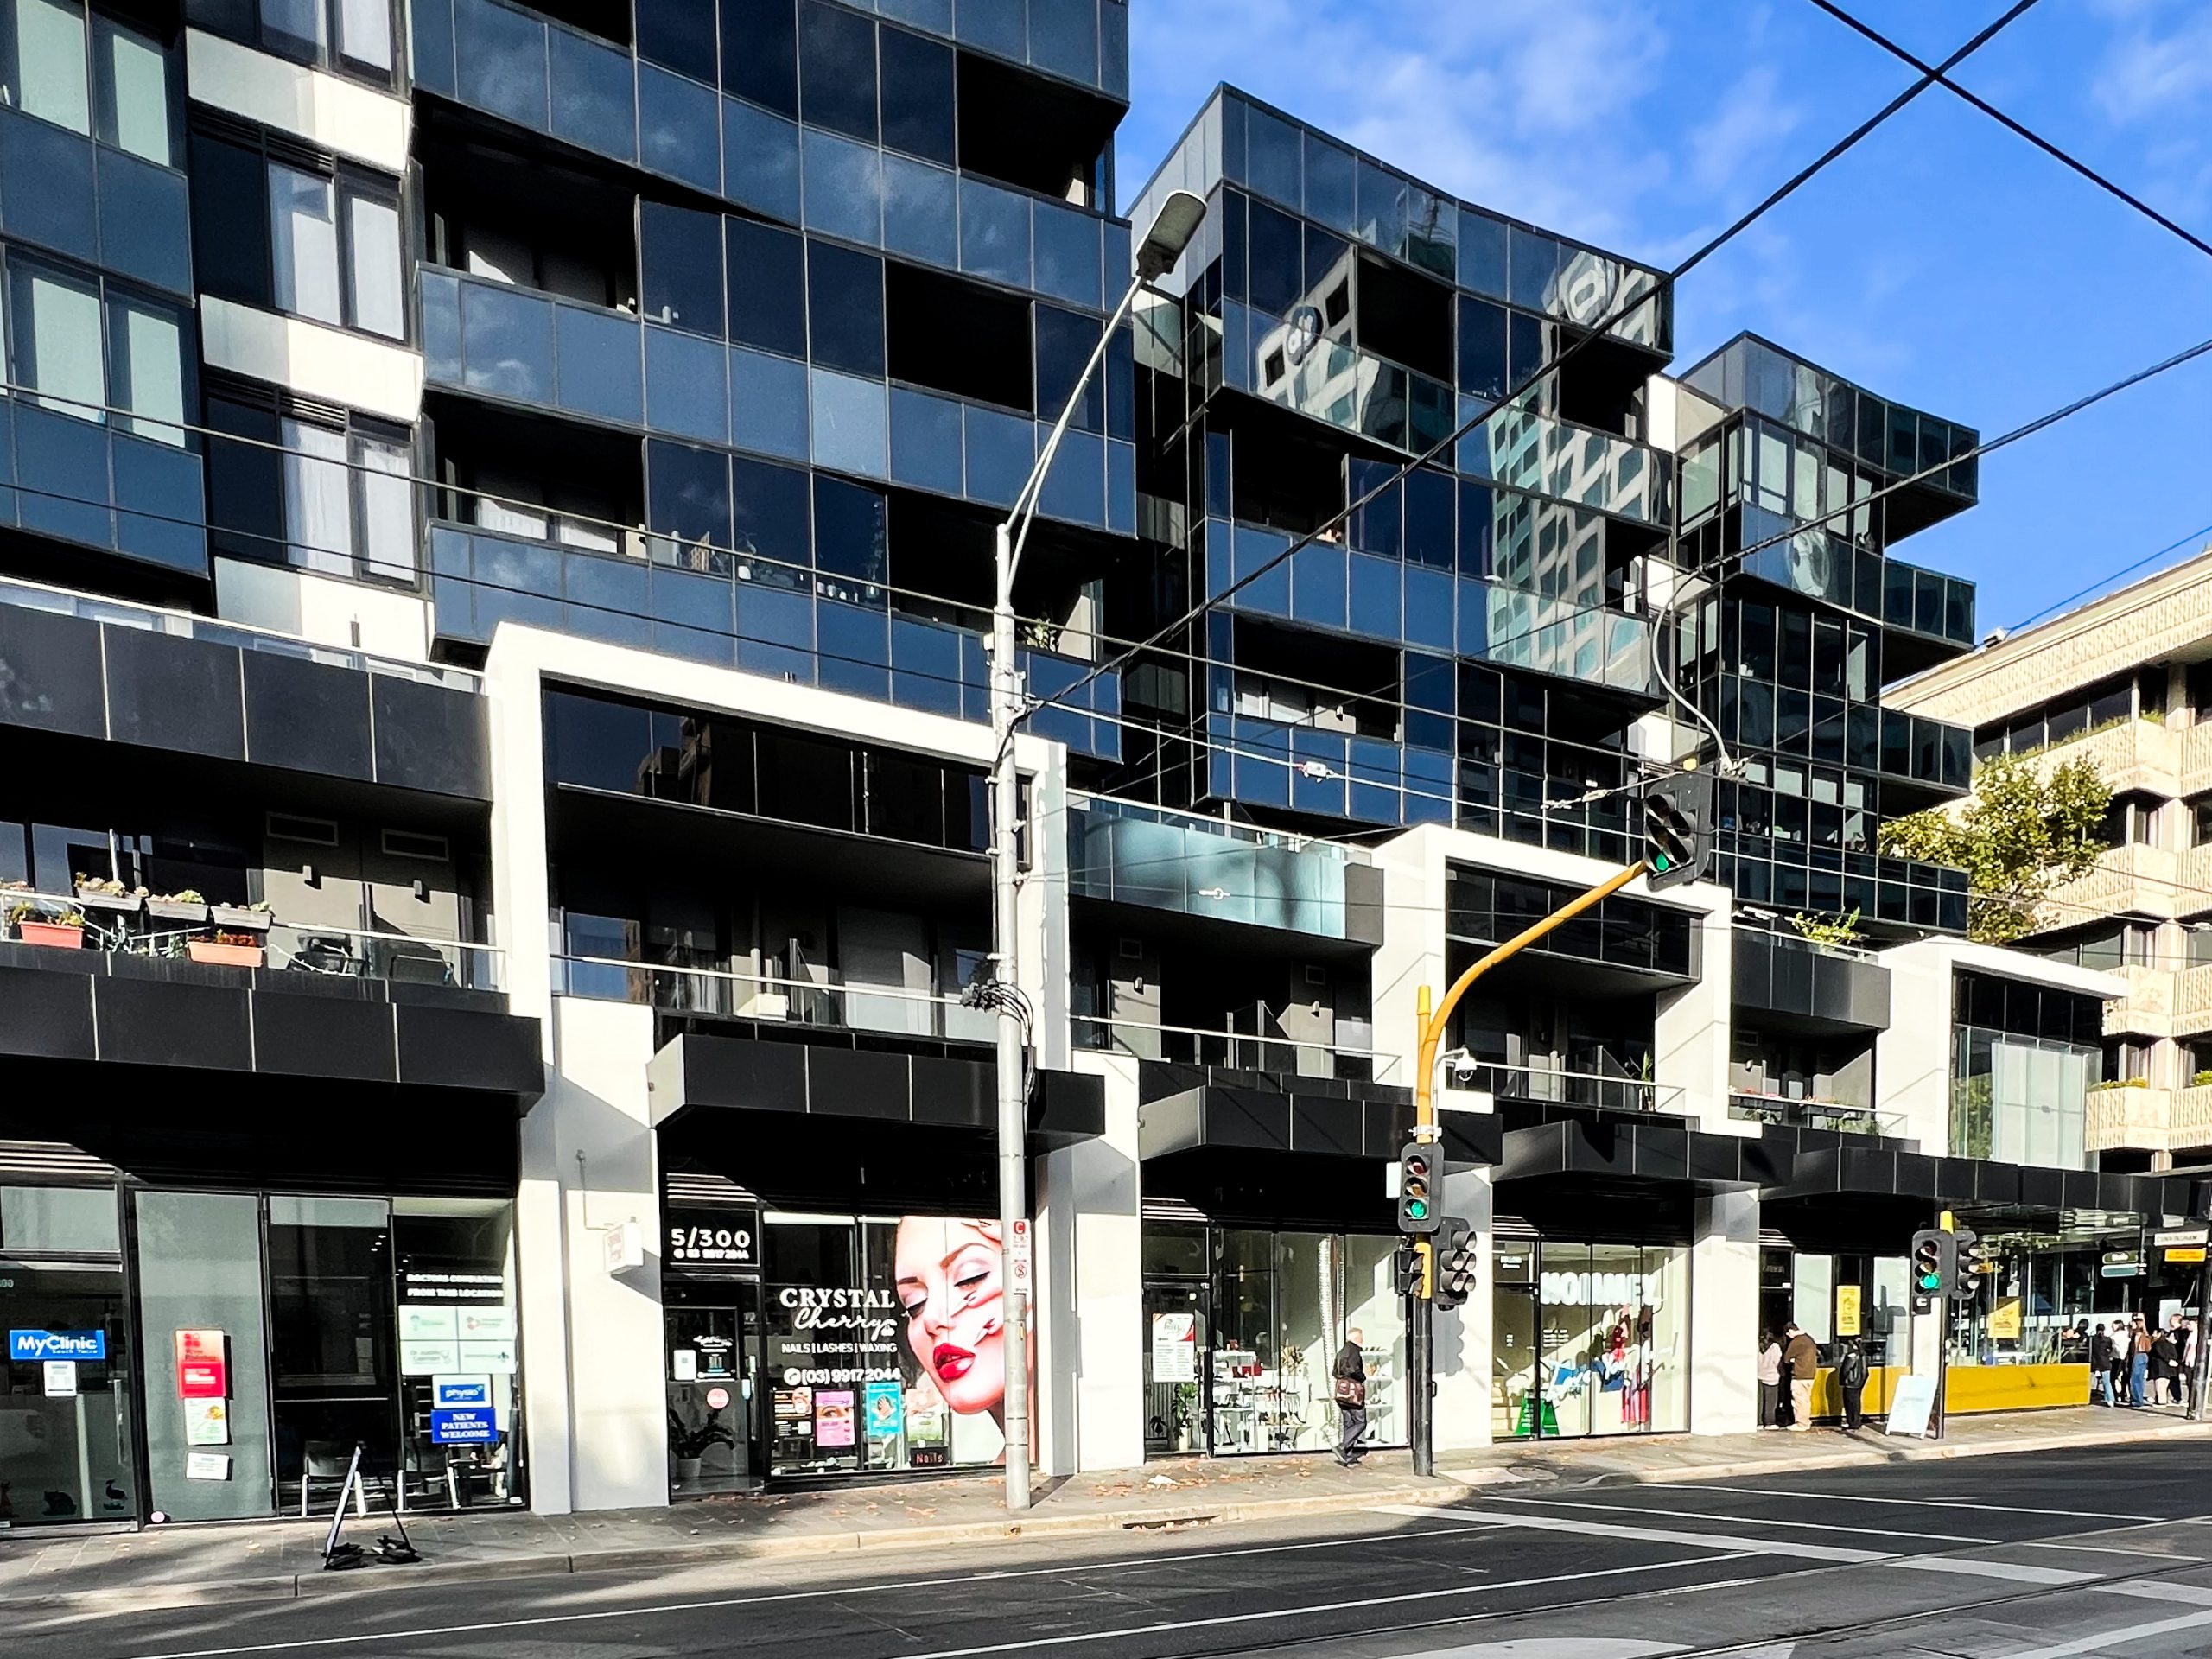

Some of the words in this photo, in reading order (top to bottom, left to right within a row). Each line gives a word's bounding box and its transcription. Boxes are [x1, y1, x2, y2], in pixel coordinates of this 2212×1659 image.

[671, 1226, 750, 1249] 5/300
[779, 1288, 895, 1308] CRYSTAL
[794, 1306, 895, 1342] Cherry
[17, 1335, 97, 1357] MyClinic
[781, 1342, 811, 1354] NAILS
[817, 1342, 854, 1354] LASHES
[859, 1343, 898, 1353] WAXING
[801, 1369, 830, 1385] (03)
[830, 1369, 864, 1382] 9917
[865, 1368, 902, 1382] 2044
[445, 1389, 479, 1398] physio
[441, 1421, 489, 1430] PATIENTS
[440, 1430, 491, 1439] WELCOME
[916, 1452, 943, 1465] Nails
